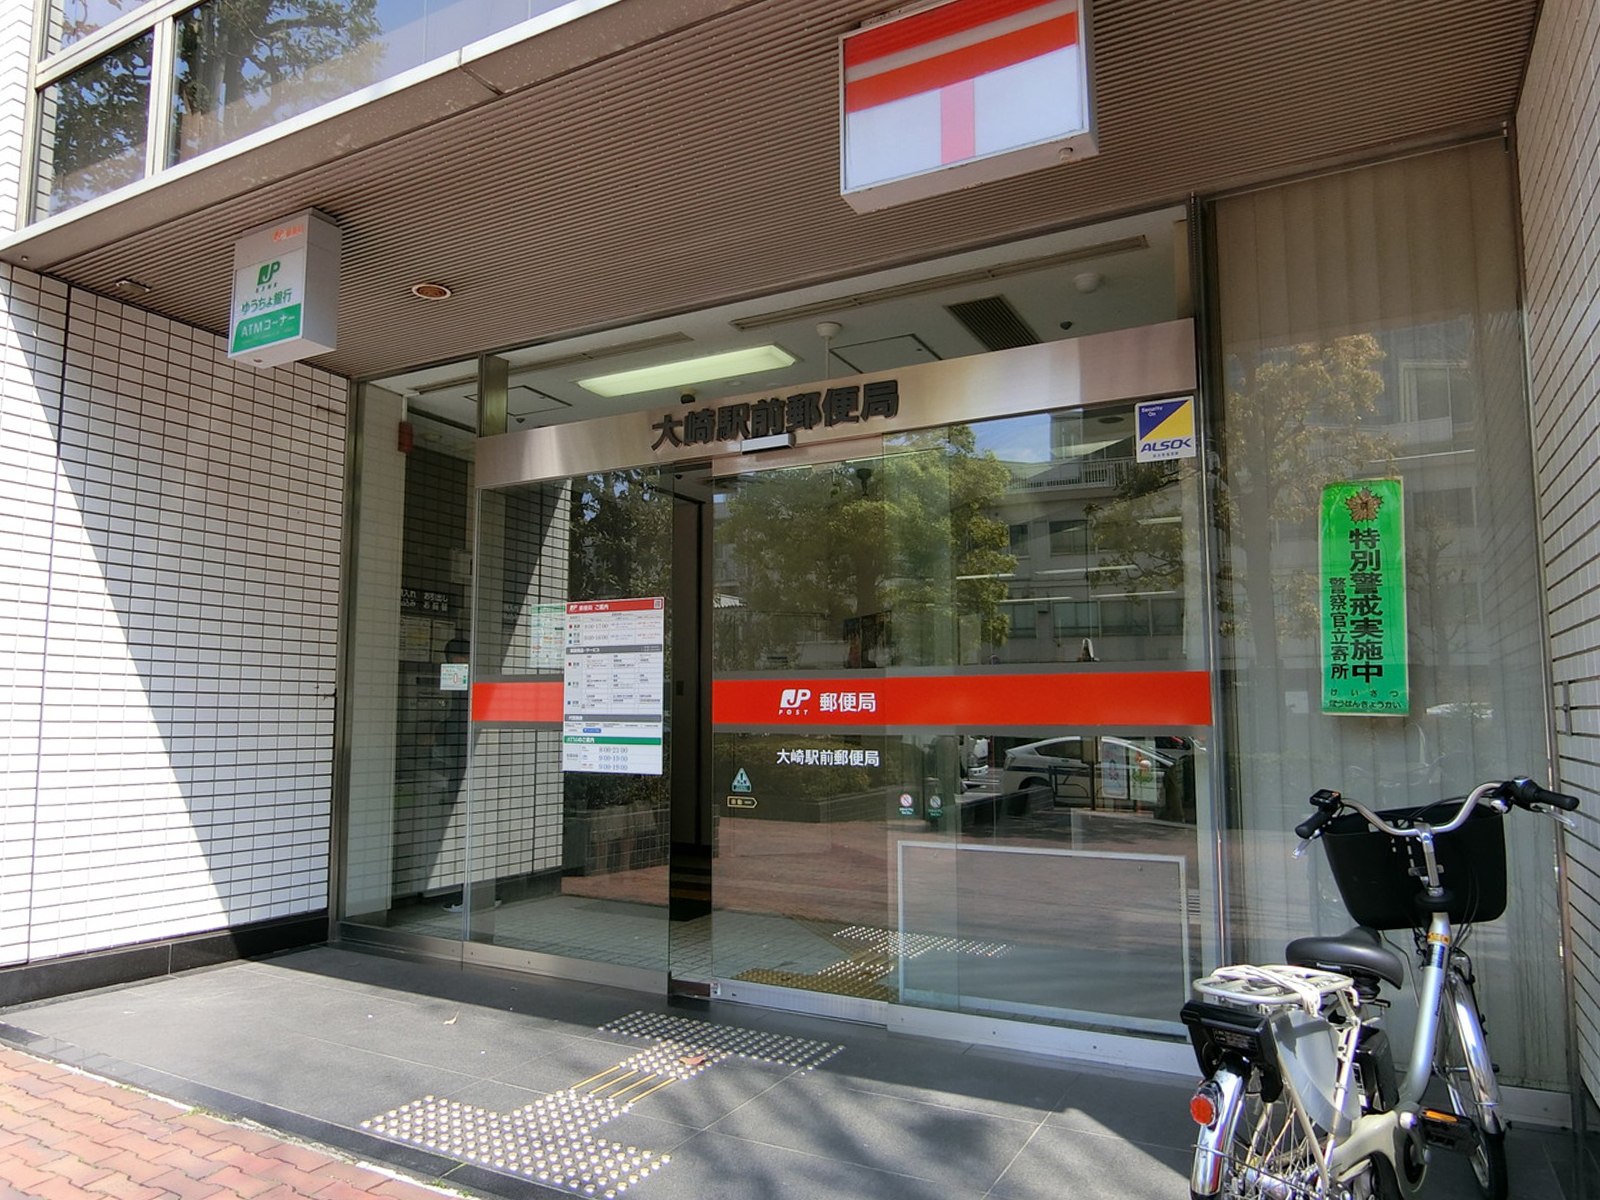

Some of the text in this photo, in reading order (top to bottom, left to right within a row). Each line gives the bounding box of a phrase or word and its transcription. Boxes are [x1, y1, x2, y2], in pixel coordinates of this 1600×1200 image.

[241, 287, 293, 316] ゆうちょ銀行
[241, 314, 296, 338] ATMコーナー
[651, 379, 899, 451] 大崎駅前郵便局
[1140, 438, 1192, 453] ALSOK
[1348, 527, 1384, 684] 特別警戒実施中
[1328, 577, 1350, 680] 警察官立寄所
[778, 708, 809, 716] POST
[819, 692, 877, 713] 郵便局
[776, 748, 880, 767] 大崎駅前郵便局
